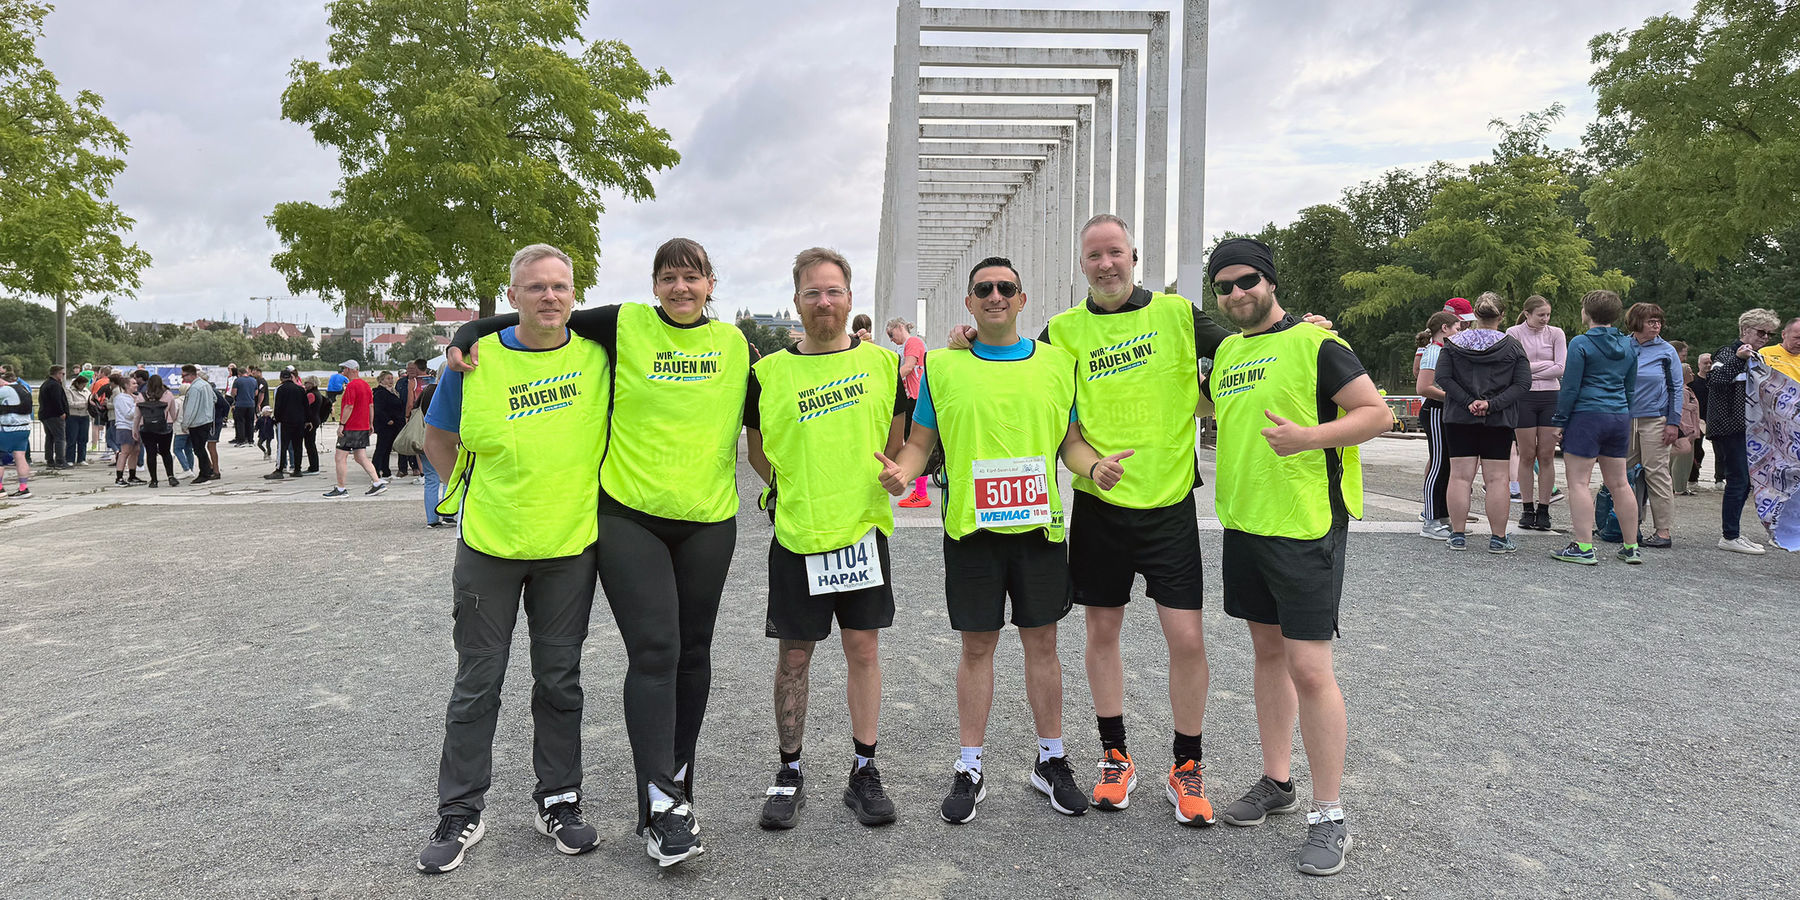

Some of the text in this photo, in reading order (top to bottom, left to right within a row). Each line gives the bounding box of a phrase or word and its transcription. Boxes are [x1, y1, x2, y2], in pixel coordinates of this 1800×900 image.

[656, 351, 673, 360] WIR
[1090, 347, 1105, 358] WIR
[653, 360, 697, 374] BAUEN
[1089, 351, 1132, 373] BAUEN
[508, 383, 534, 395] WIR
[798, 388, 815, 399] WIR
[1777, 386, 1797, 410] 333
[508, 387, 558, 411] BAUEN
[798, 389, 843, 413] BAUEN
[986, 478, 1037, 506] 5018
[980, 509, 1030, 522] WEMAG
[822, 543, 868, 571] 1104
[817, 569, 869, 587] HAPAK
